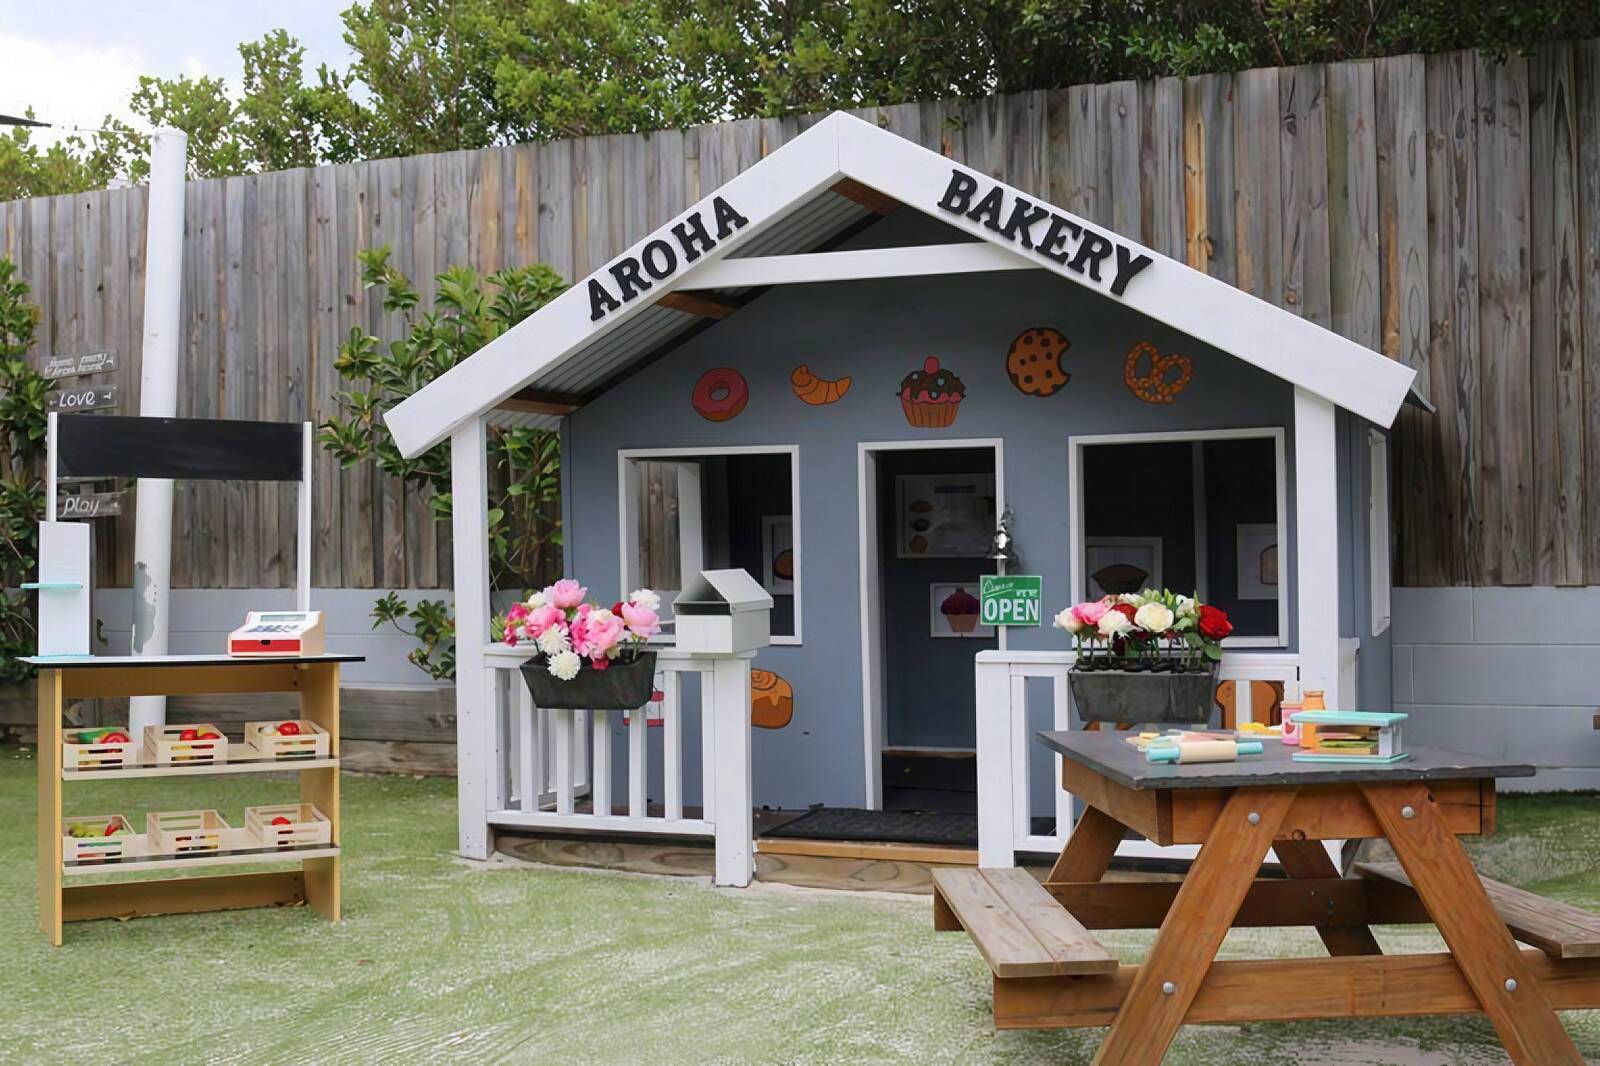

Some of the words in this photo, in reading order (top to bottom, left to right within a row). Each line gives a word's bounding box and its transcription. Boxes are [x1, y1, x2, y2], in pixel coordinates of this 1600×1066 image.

[588, 196, 749, 322] AROHA
[937, 169, 1154, 297] BAKERY
[984, 599, 1039, 621] OPEN
